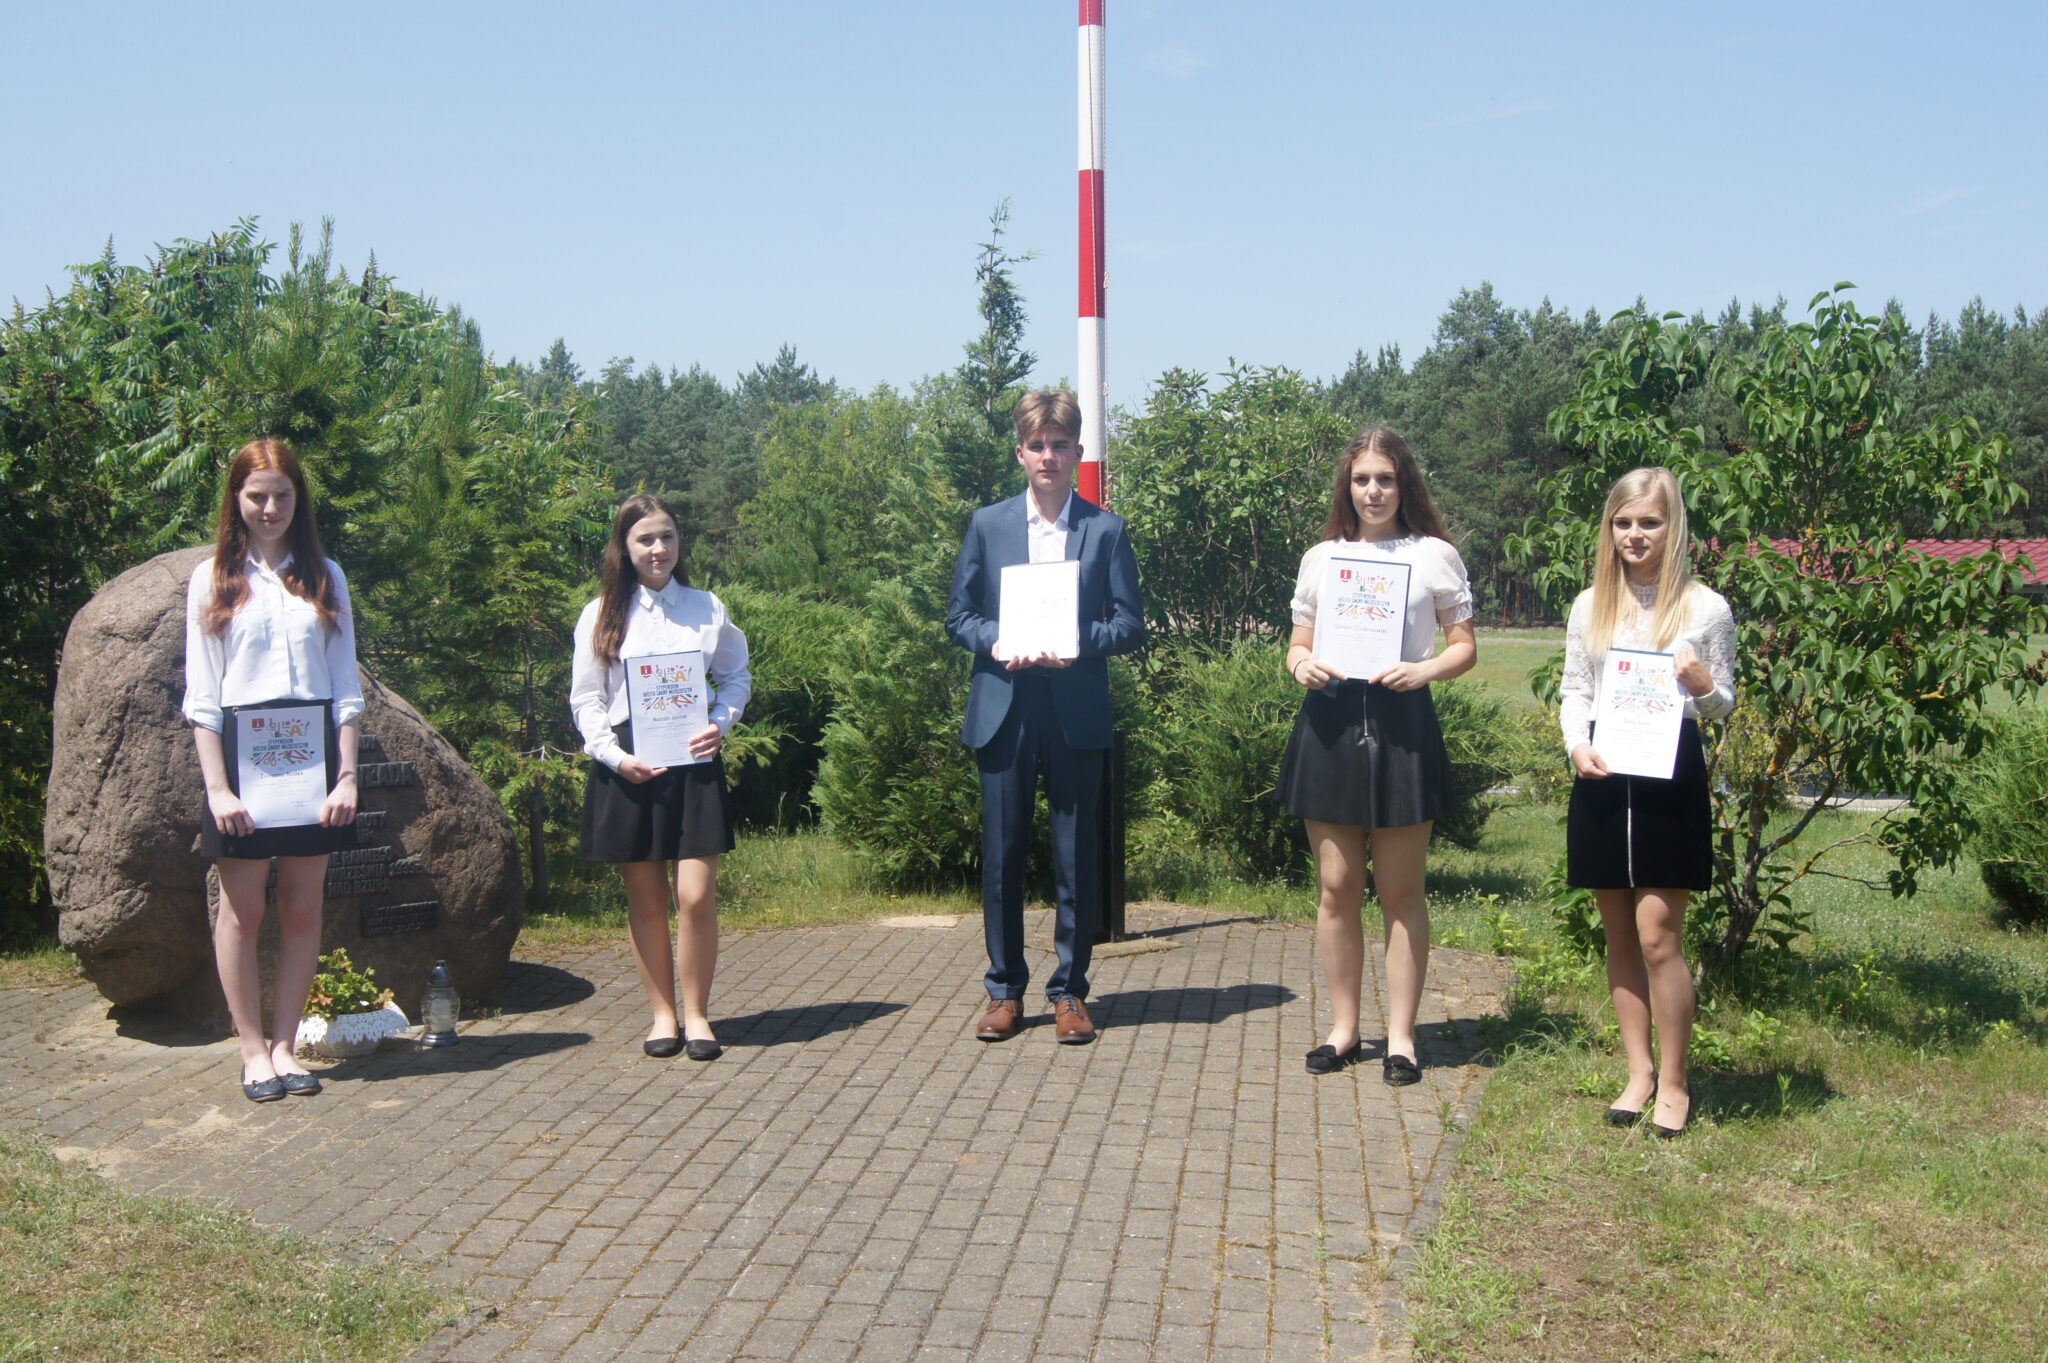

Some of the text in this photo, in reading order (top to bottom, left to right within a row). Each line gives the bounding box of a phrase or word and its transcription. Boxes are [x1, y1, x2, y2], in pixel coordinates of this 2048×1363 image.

[342, 845, 392, 867] RANNEGO
[328, 863, 386, 881] WRZEŚNIA
[328, 880, 352, 898] NAD
